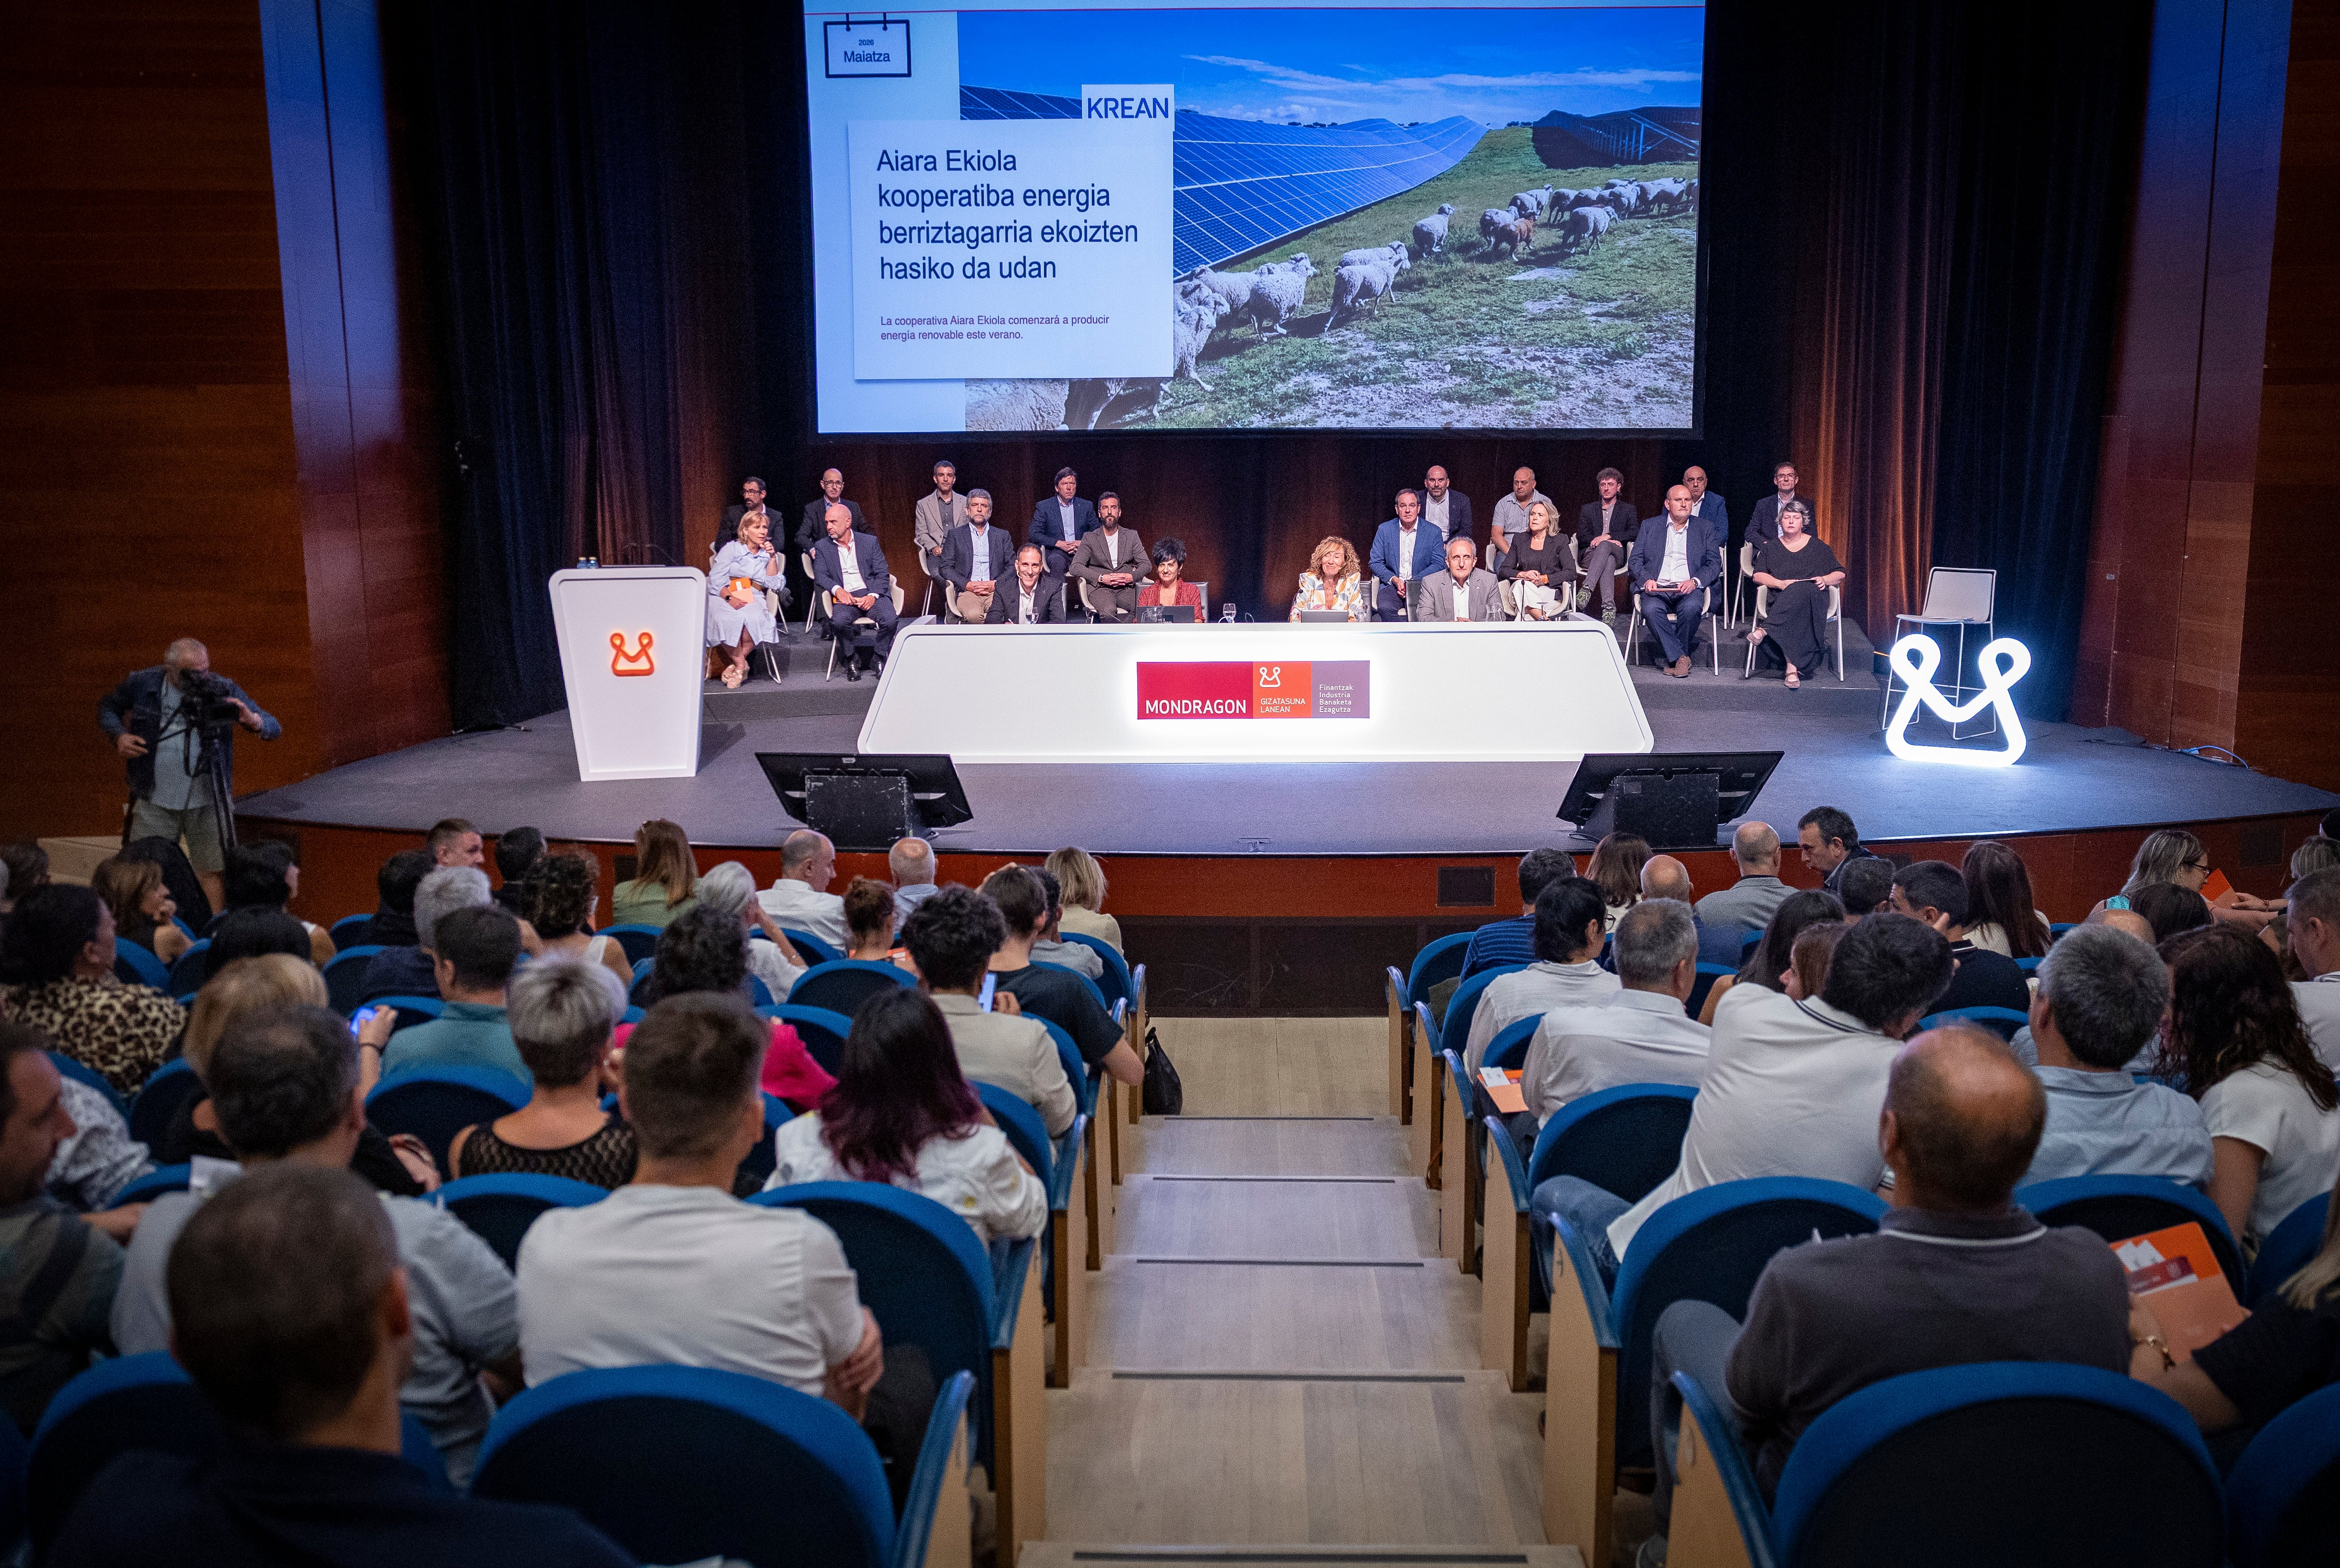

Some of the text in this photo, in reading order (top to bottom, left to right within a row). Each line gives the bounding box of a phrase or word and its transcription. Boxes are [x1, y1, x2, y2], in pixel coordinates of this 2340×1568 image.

[844, 50, 891, 63] Maiatza
[1088, 97, 1169, 119] KREAN
[877, 149, 1017, 172] Aiara Ekiola
[878, 183, 1110, 213] kooperatiba energia
[879, 219, 1138, 250] berriztagarria ekoizten
[880, 255, 1056, 279] hasiko da udan
[881, 316, 892, 326] La
[895, 315, 948, 328] cooperativa
[950, 315, 974, 325] Aiara
[977, 315, 1006, 325] Ekiola
[1008, 314, 1060, 324] comenzará
[1071, 314, 1110, 327] producir
[880, 330, 916, 342] energía
[918, 330, 964, 339] renovable
[966, 330, 986, 339] este
[1145, 699, 1246, 715] MONDRAGON
